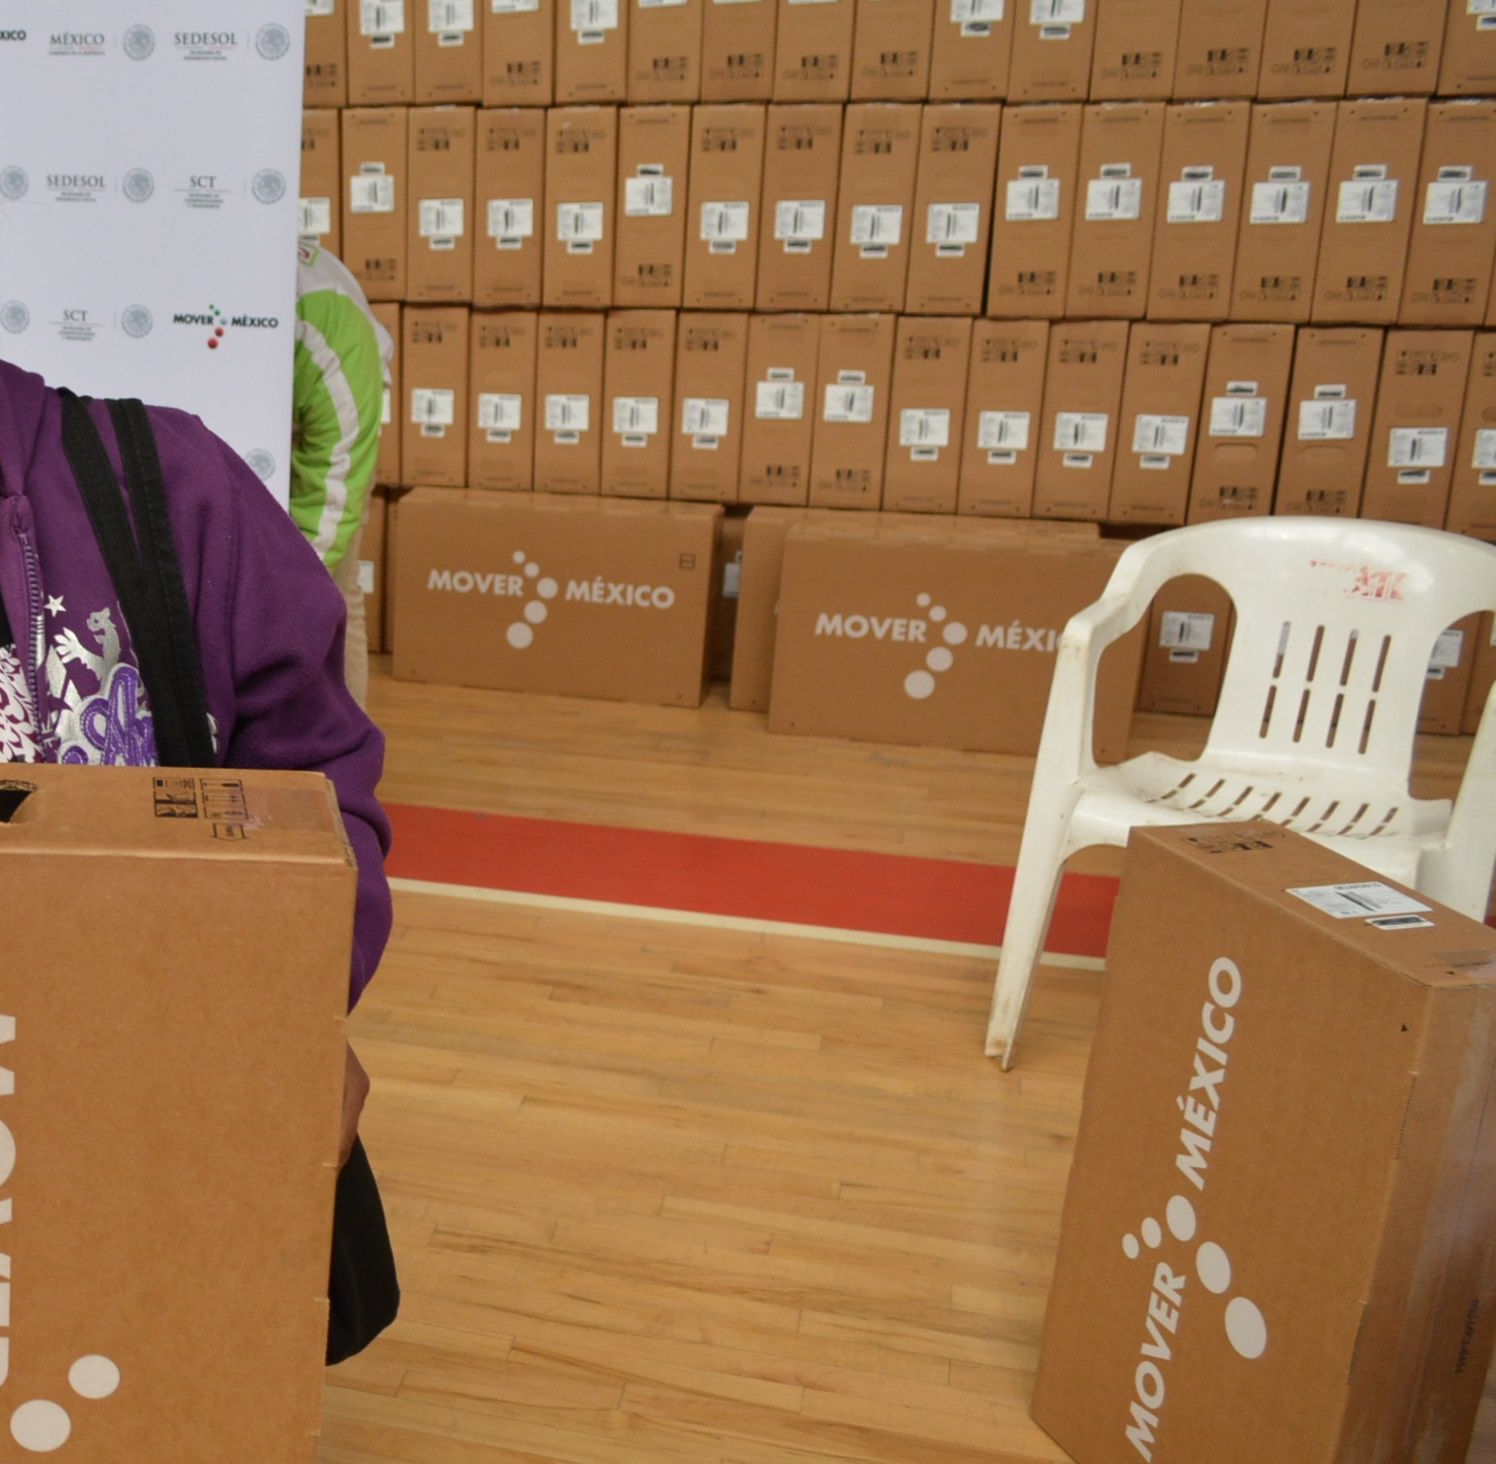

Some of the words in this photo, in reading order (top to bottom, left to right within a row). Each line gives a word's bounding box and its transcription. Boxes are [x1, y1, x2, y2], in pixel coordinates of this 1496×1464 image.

[50, 31, 105, 46] MÉXICO
[174, 32, 238, 46] SEDESOL
[46, 174, 107, 188] SEDESOL
[189, 175, 217, 189] SCT
[63, 308, 89, 322] SCT
[173, 313, 214, 326] MOVER
[231, 311, 279, 329] MÉXICO
[427, 569, 525, 597] MOVER
[565, 575, 676, 609] MÉXICO
[814, 612, 927, 643] MOVER
[975, 620, 1066, 653] MÉXI
[1175, 957, 1242, 1191] MÉXICO
[1125, 1262, 1187, 1463] MOVER
